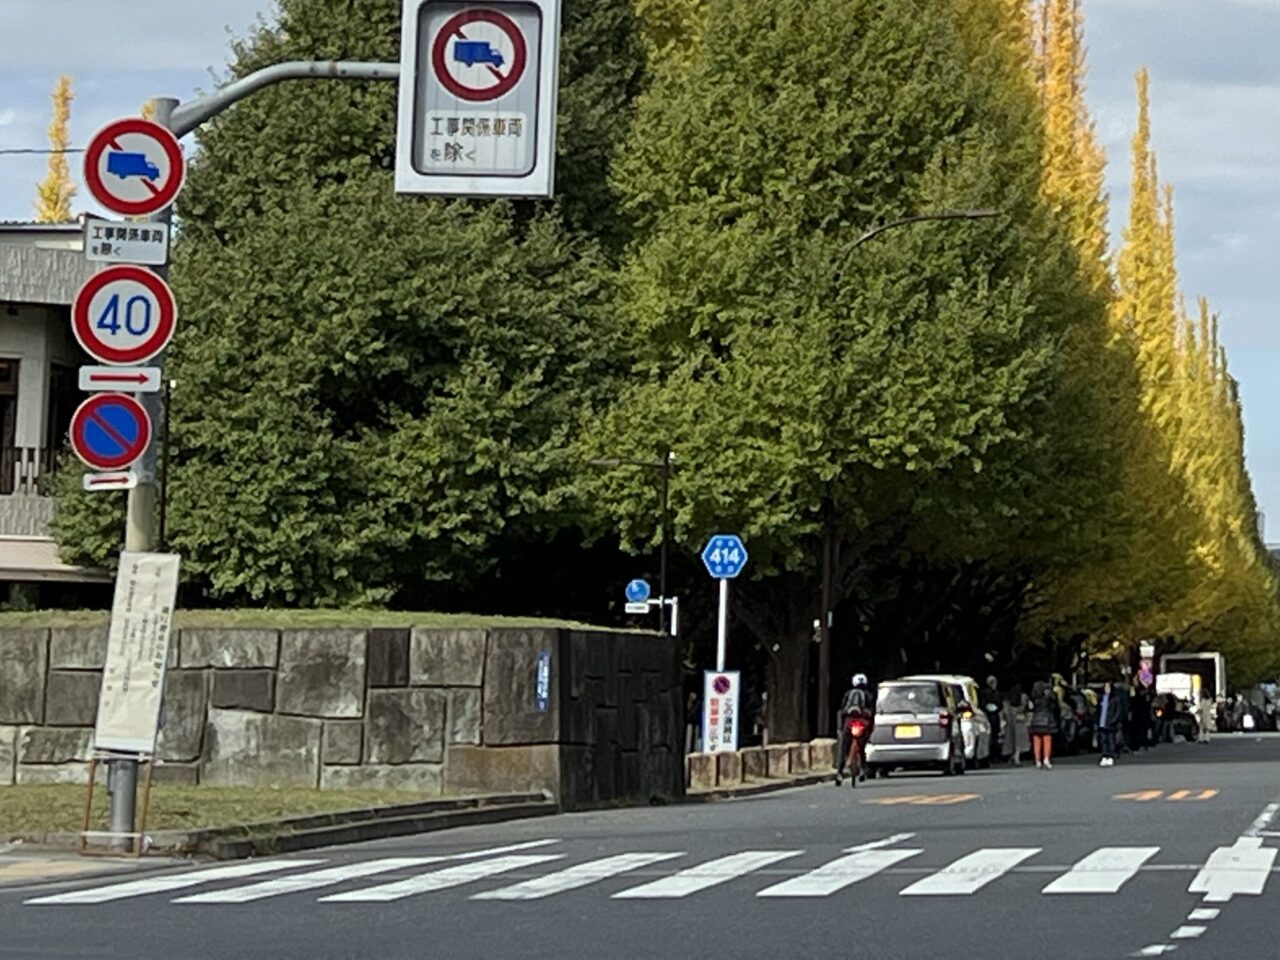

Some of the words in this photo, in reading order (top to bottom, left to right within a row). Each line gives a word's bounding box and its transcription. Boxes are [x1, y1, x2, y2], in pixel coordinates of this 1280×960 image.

[431, 118, 522, 137] 工事関係車両
[431, 142, 476, 162] を除く
[93, 227, 163, 243] 工事関係車両
[97, 294, 151, 335] 40
[709, 548, 740, 564] 414
